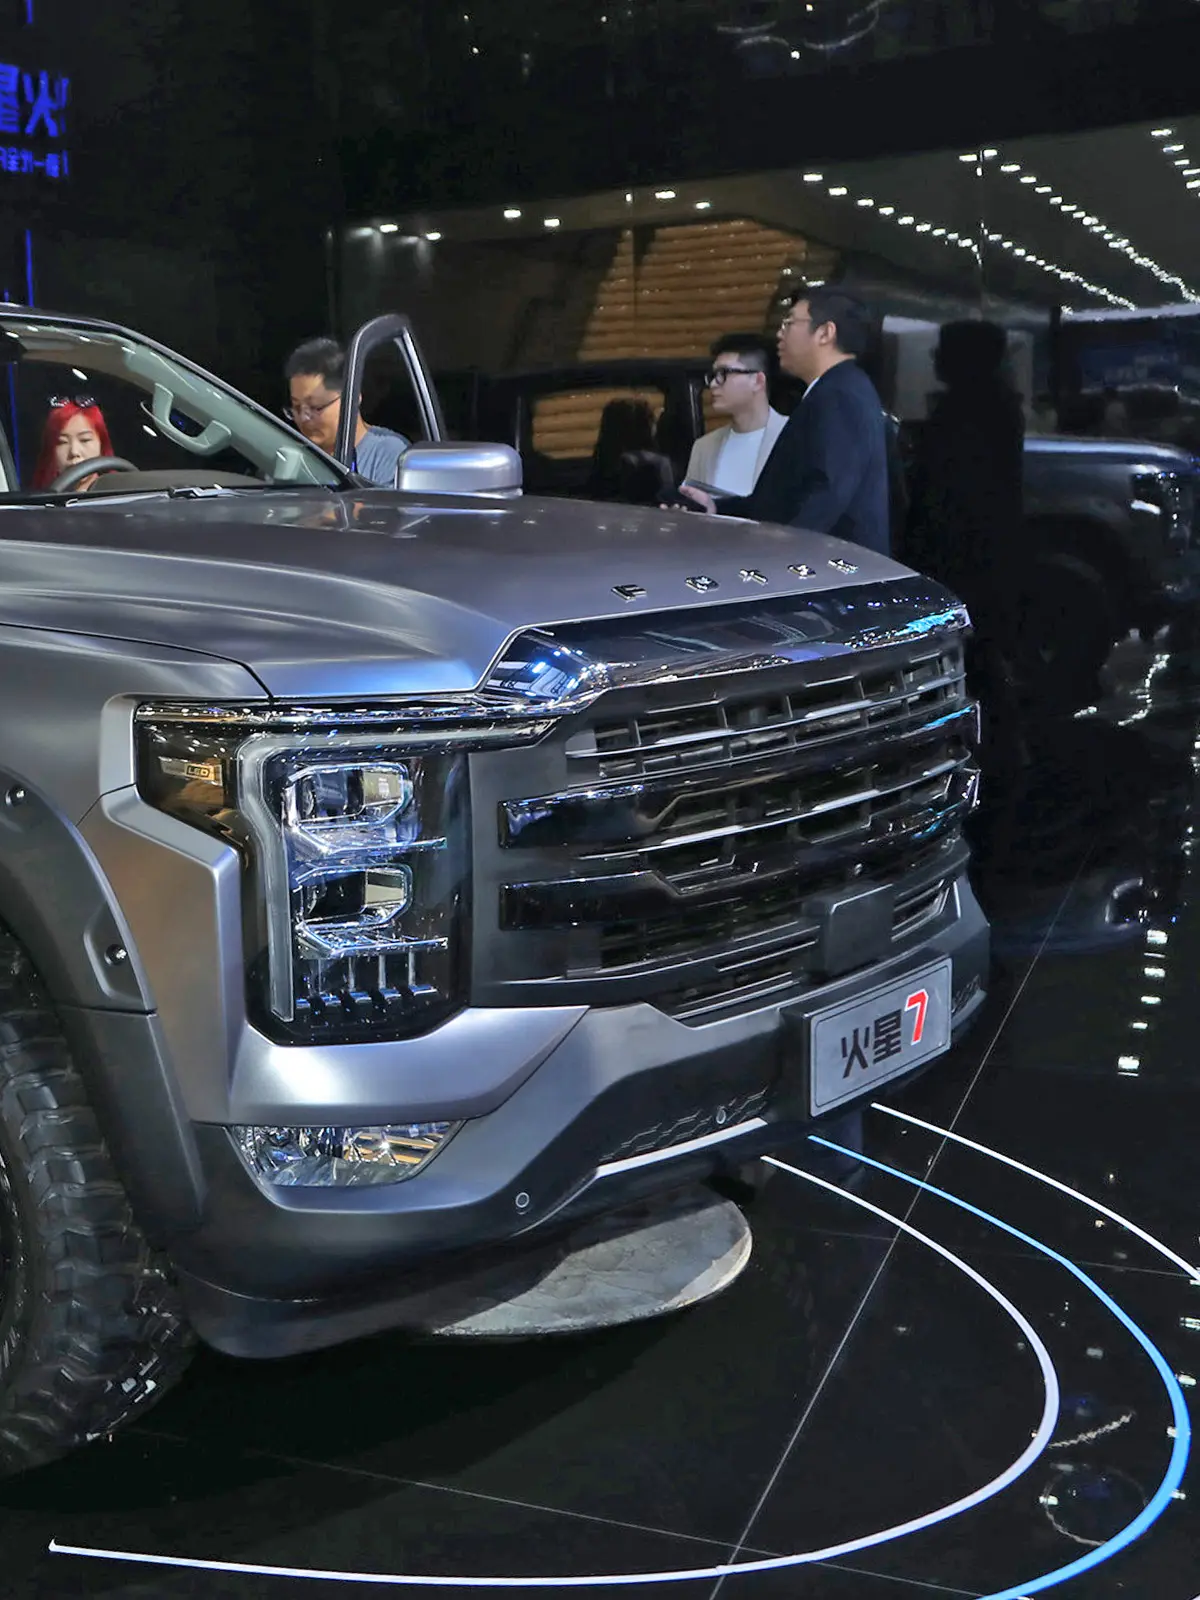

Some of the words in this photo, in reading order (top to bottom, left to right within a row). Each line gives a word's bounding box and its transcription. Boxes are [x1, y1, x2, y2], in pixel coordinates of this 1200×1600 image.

[611, 558, 859, 602] FOTON
[186, 765, 211, 778] LED
[841, 989, 929, 1079] 火星7
